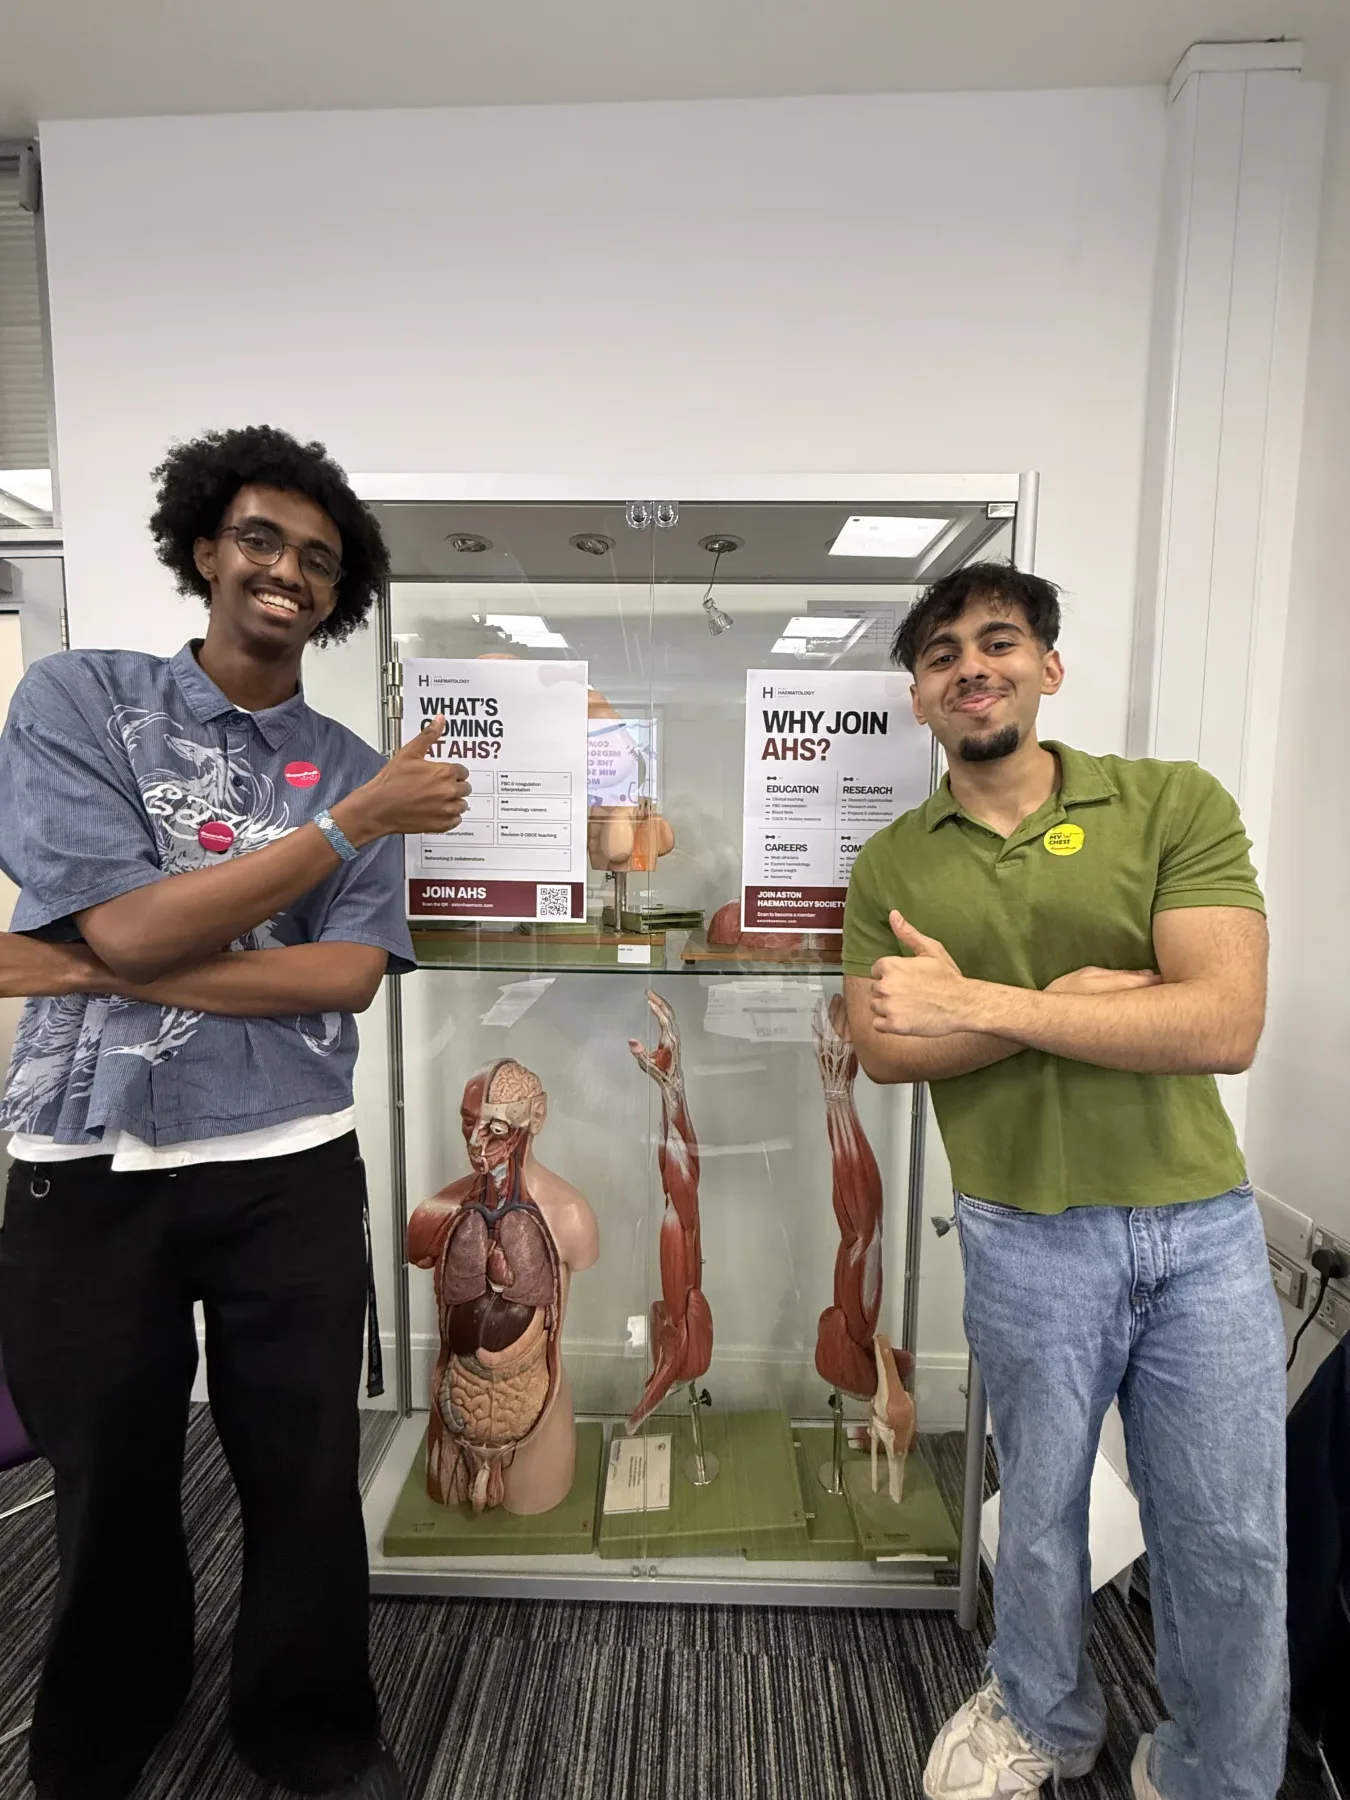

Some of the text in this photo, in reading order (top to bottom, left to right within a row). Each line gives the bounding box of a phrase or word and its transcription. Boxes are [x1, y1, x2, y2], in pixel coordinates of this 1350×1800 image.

[418, 675, 429, 687] H
[763, 686, 773, 698] H
[420, 697, 498, 716] WHAT'S
[762, 710, 888, 734] WHY JOIN
[448, 741, 501, 759] AHS?
[761, 738, 831, 761] AHS?
[767, 785, 819, 793] EDUCATION
[843, 786, 893, 794] RESEARCH
[765, 844, 808, 852] CAREERS
[422, 886, 487, 899] JOIN AHS
